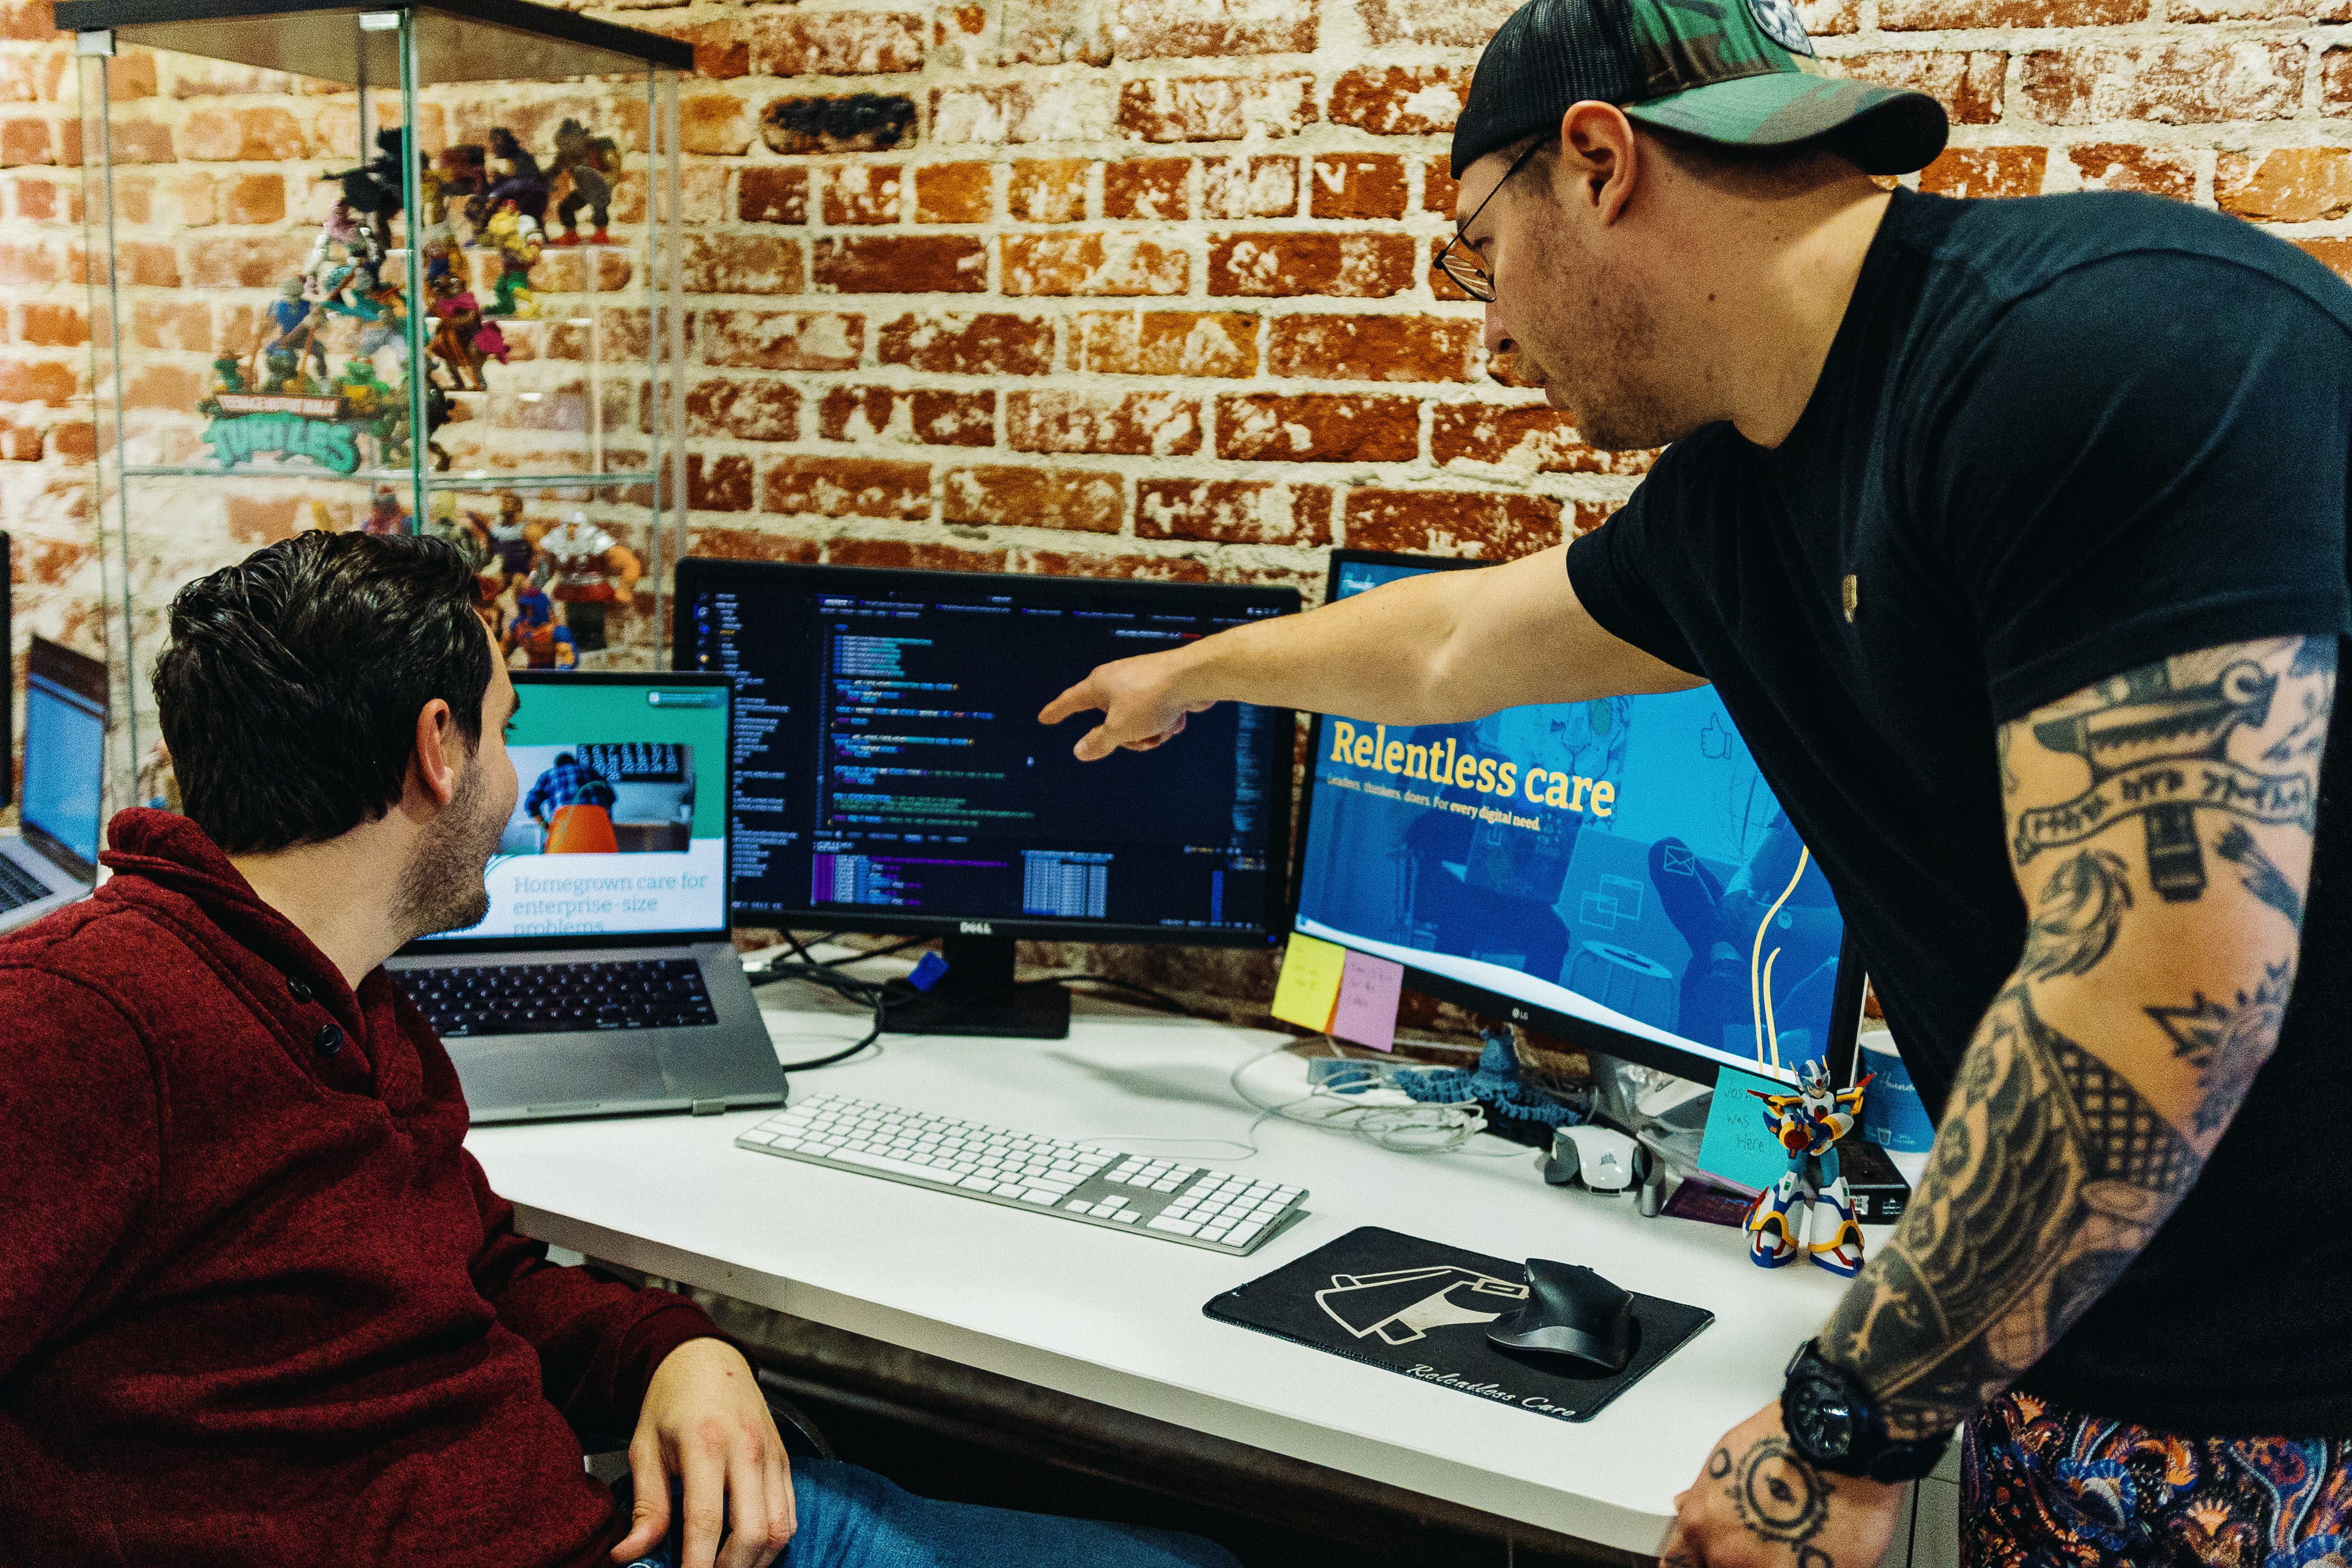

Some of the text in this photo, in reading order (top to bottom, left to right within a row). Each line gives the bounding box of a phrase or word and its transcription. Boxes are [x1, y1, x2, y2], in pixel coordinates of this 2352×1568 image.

[1330, 721, 1517, 797] Relentless
[1524, 768, 1616, 817] care
[1433, 790, 1449, 810] For
[1450, 802, 1478, 820] every
[1479, 806, 1512, 824] digital
[1513, 815, 1541, 831] need.
[514, 871, 707, 895] Homegrown care for
[514, 896, 658, 918] enterprise-size
[514, 918, 604, 935] problems
[1406, 1364, 1576, 1416] Relentless Care
